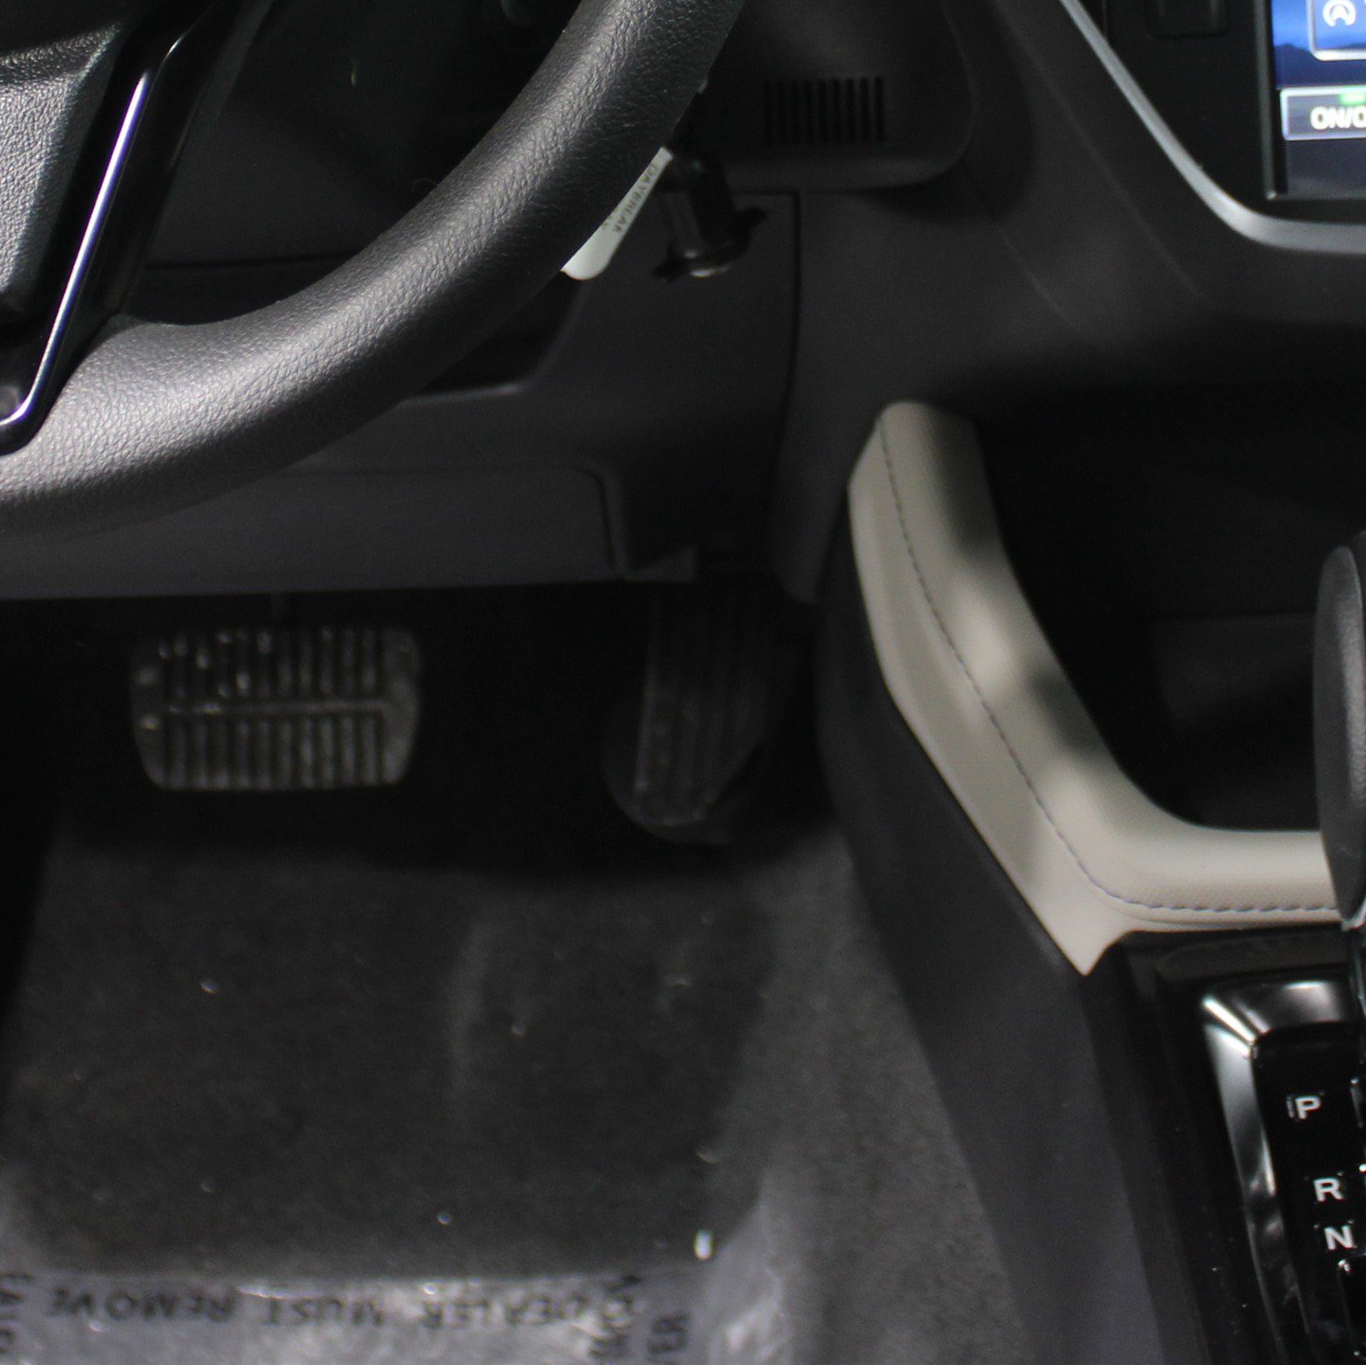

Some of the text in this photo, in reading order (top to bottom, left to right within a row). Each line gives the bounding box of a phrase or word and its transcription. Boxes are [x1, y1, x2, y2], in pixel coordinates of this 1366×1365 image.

[1295, 1096, 1321, 1120] P
[1313, 1178, 1345, 1202] R
[1324, 1225, 1356, 1250] N
